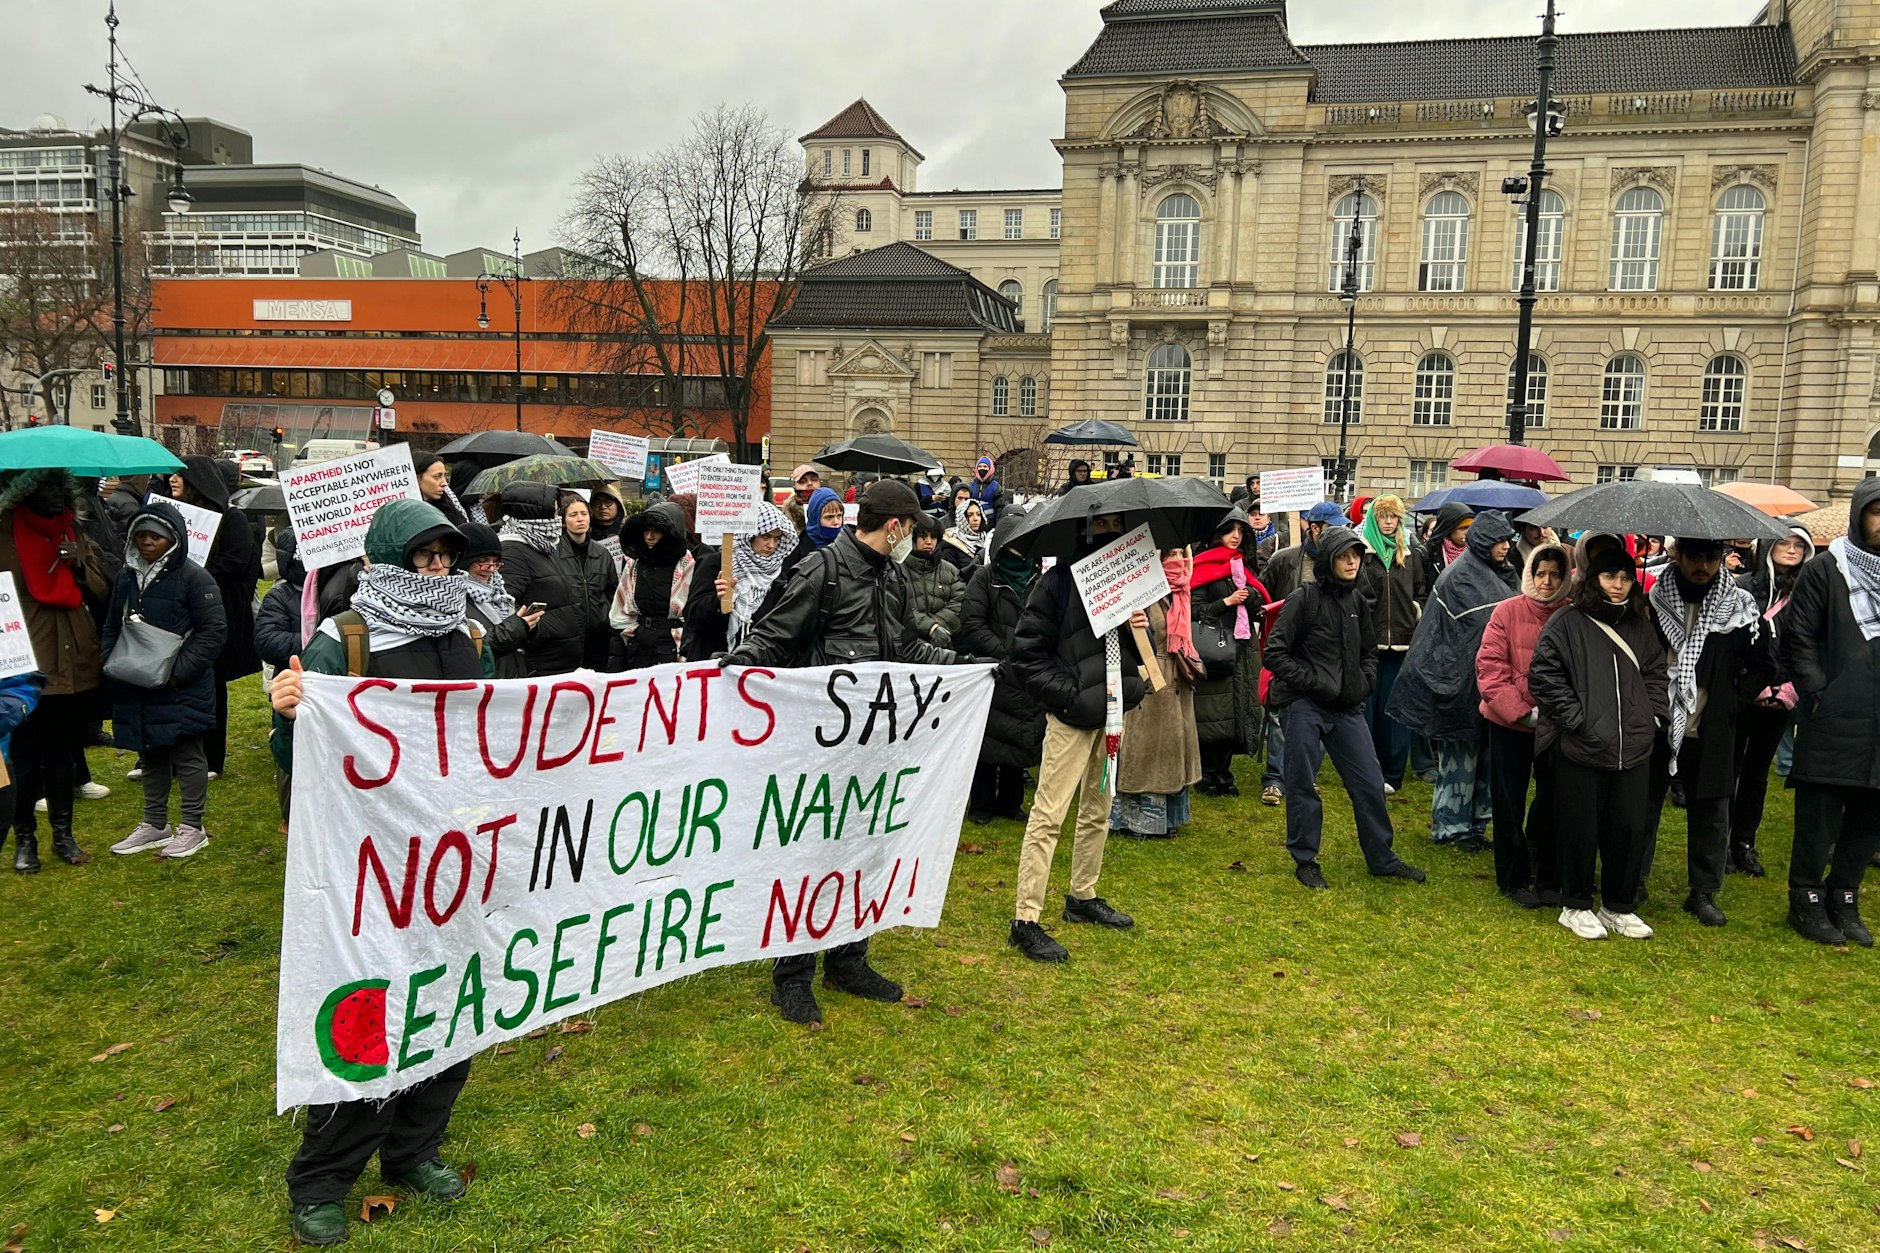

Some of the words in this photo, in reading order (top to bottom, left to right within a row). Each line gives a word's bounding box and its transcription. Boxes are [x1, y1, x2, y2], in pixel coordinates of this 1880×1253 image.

[267, 300, 339, 320] MENSA
[344, 464, 353, 473] IS
[354, 459, 375, 471] NOT
[289, 479, 349, 501] ACCEPTABLE
[350, 467, 401, 486] ANYWHERE
[402, 463, 411, 473] IN
[291, 503, 311, 515] THE
[311, 494, 351, 510] WORLD.
[353, 489, 366, 499] SO
[367, 483, 389, 495] WHY
[391, 478, 409, 489] HAS
[295, 517, 315, 528] THE
[315, 507, 351, 523] WORLD
[300, 523, 343, 542] AGAINST
[344, 514, 374, 530] PALES
[193, 531, 208, 542] FOR
[306, 535, 359, 555] ORGANISATION
[338, 542, 362, 553] AMNES
[1092, 557, 1102, 569] ARE
[1102, 544, 1125, 561] FAILING
[1110, 558, 1121, 569] THE
[1121, 548, 1139, 562] LAND,
[1085, 573, 1116, 597] APARTHEID
[1117, 562, 1136, 576] RULES.
[1136, 554, 1148, 565] THIS
[1093, 579, 1127, 603] TEXT-BOOK
[1127, 570, 1143, 582] CASE
[1143, 564, 1150, 574] OF
[1116, 602, 1132, 614] HUMAN
[1133, 592, 1149, 604] RIGHTS
[1149, 580, 1166, 594] LAWYER
[5, 621, 22, 632] IHR
[343, 667, 776, 790] STUDENTS
[815, 669, 950, 748] SAY:
[352, 813, 517, 938] NOT
[528, 798, 593, 893] IN
[608, 777, 729, 876] OUR
[753, 767, 920, 850] NAME
[760, 857, 919, 949] NOW!
